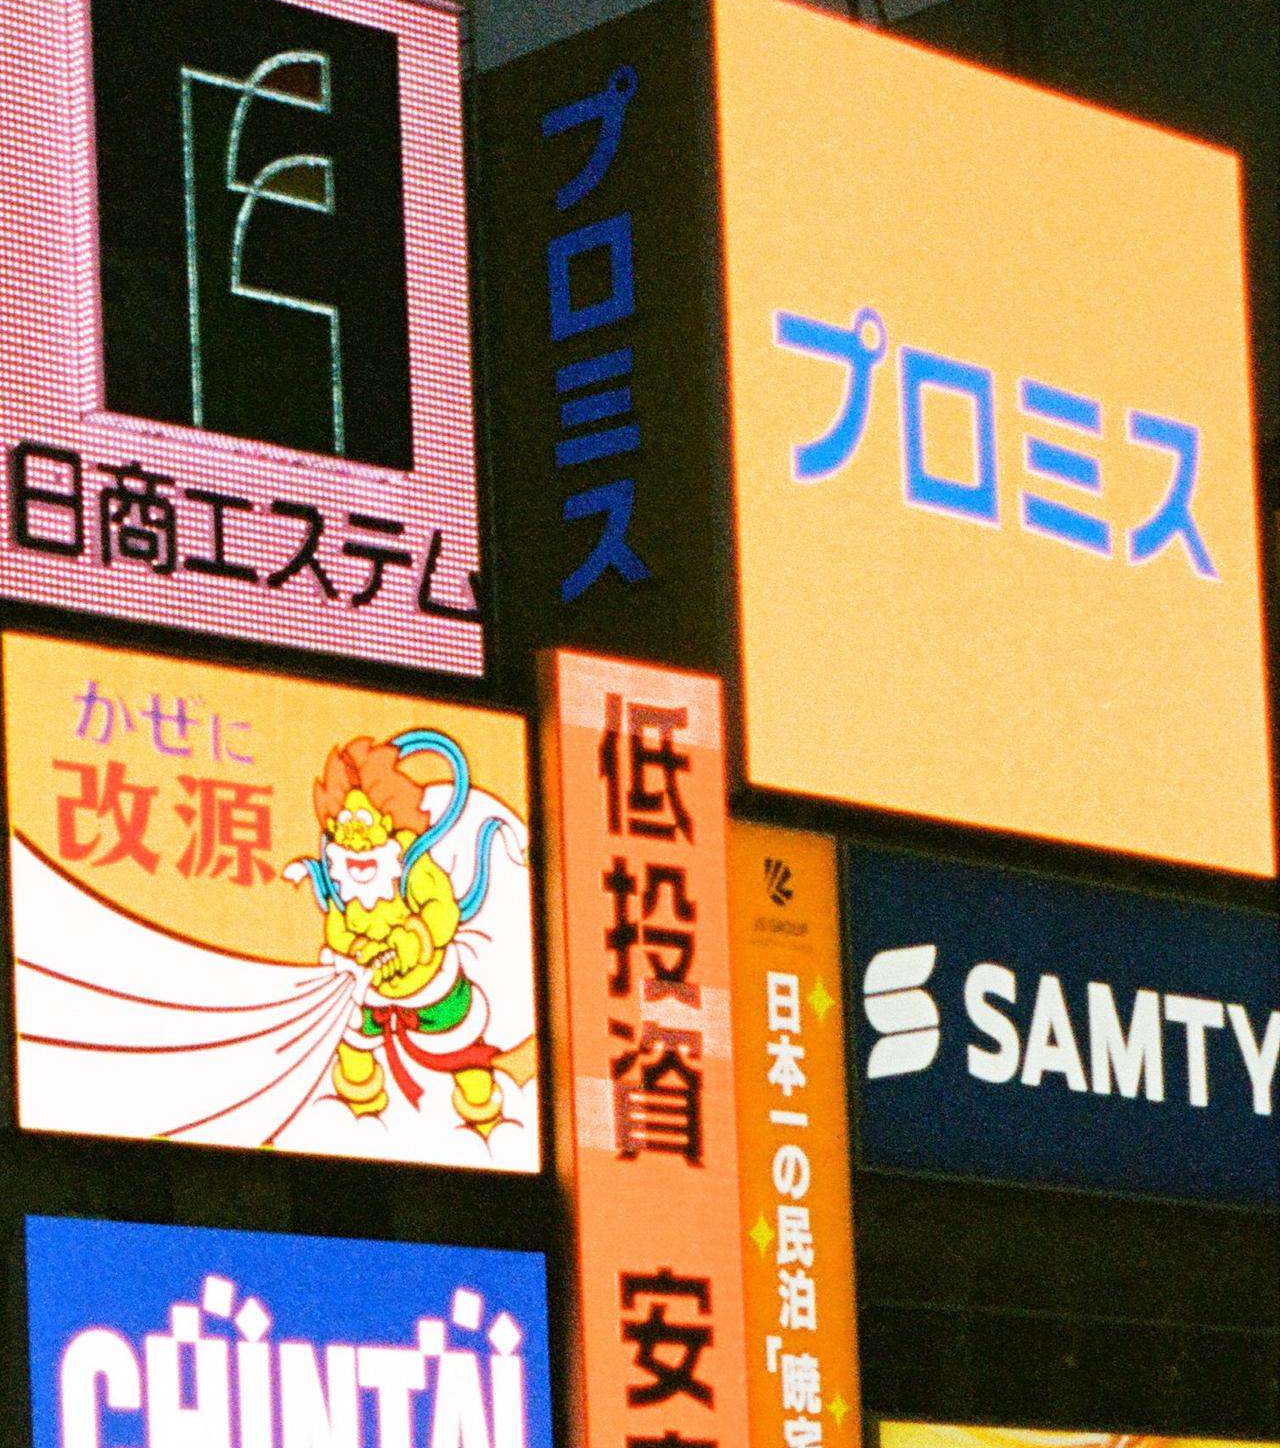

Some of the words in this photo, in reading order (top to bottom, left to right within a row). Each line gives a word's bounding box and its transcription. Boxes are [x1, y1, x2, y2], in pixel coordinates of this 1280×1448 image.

[540, 62, 651, 605] プロミス
[9, 440, 481, 622] 日商エステム
[773, 306, 1223, 584] プロミス
[73, 678, 256, 767] かぜに
[51, 756, 276, 888] 改源
[598, 693, 707, 1169] 低投資
[963, 961, 1280, 1116] SAMTY
